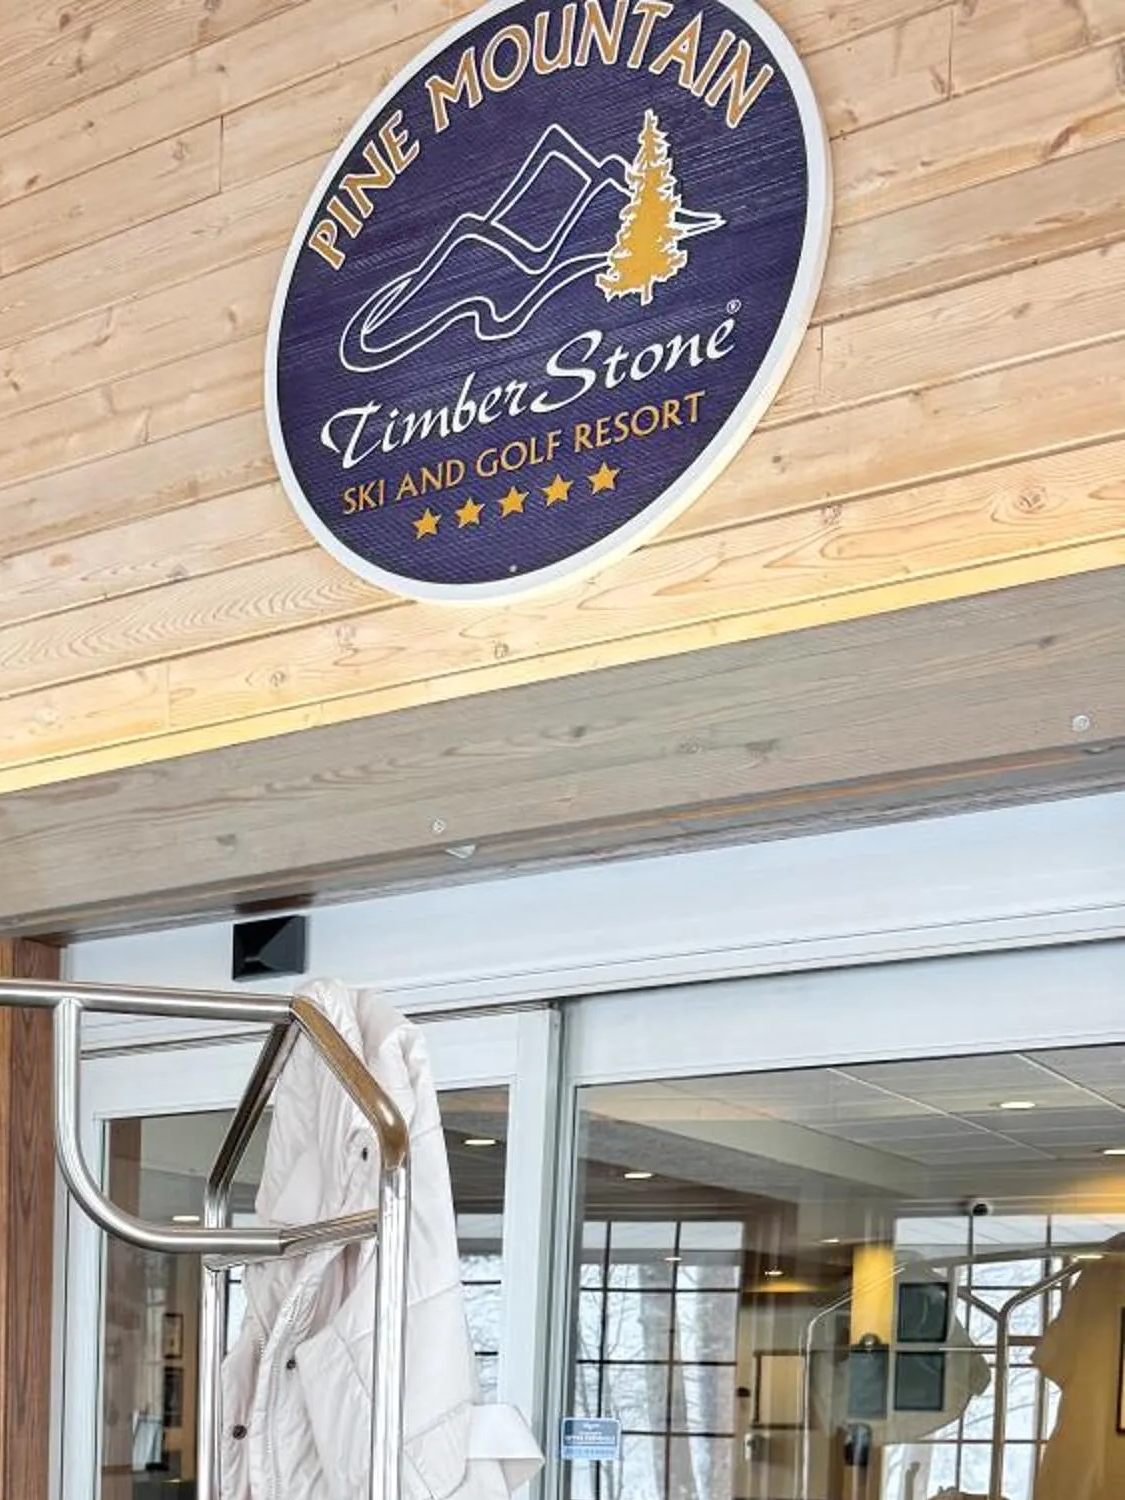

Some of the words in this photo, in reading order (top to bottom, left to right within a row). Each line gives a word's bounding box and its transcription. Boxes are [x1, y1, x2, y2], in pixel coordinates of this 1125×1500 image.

[307, 109, 421, 270] PINE
[425, 0, 775, 131] MOUNTAIN
[342, 479, 385, 515] SKI
[395, 457, 465, 501] AND
[475, 430, 563, 478] GOLF
[574, 390, 708, 453] RESORT
